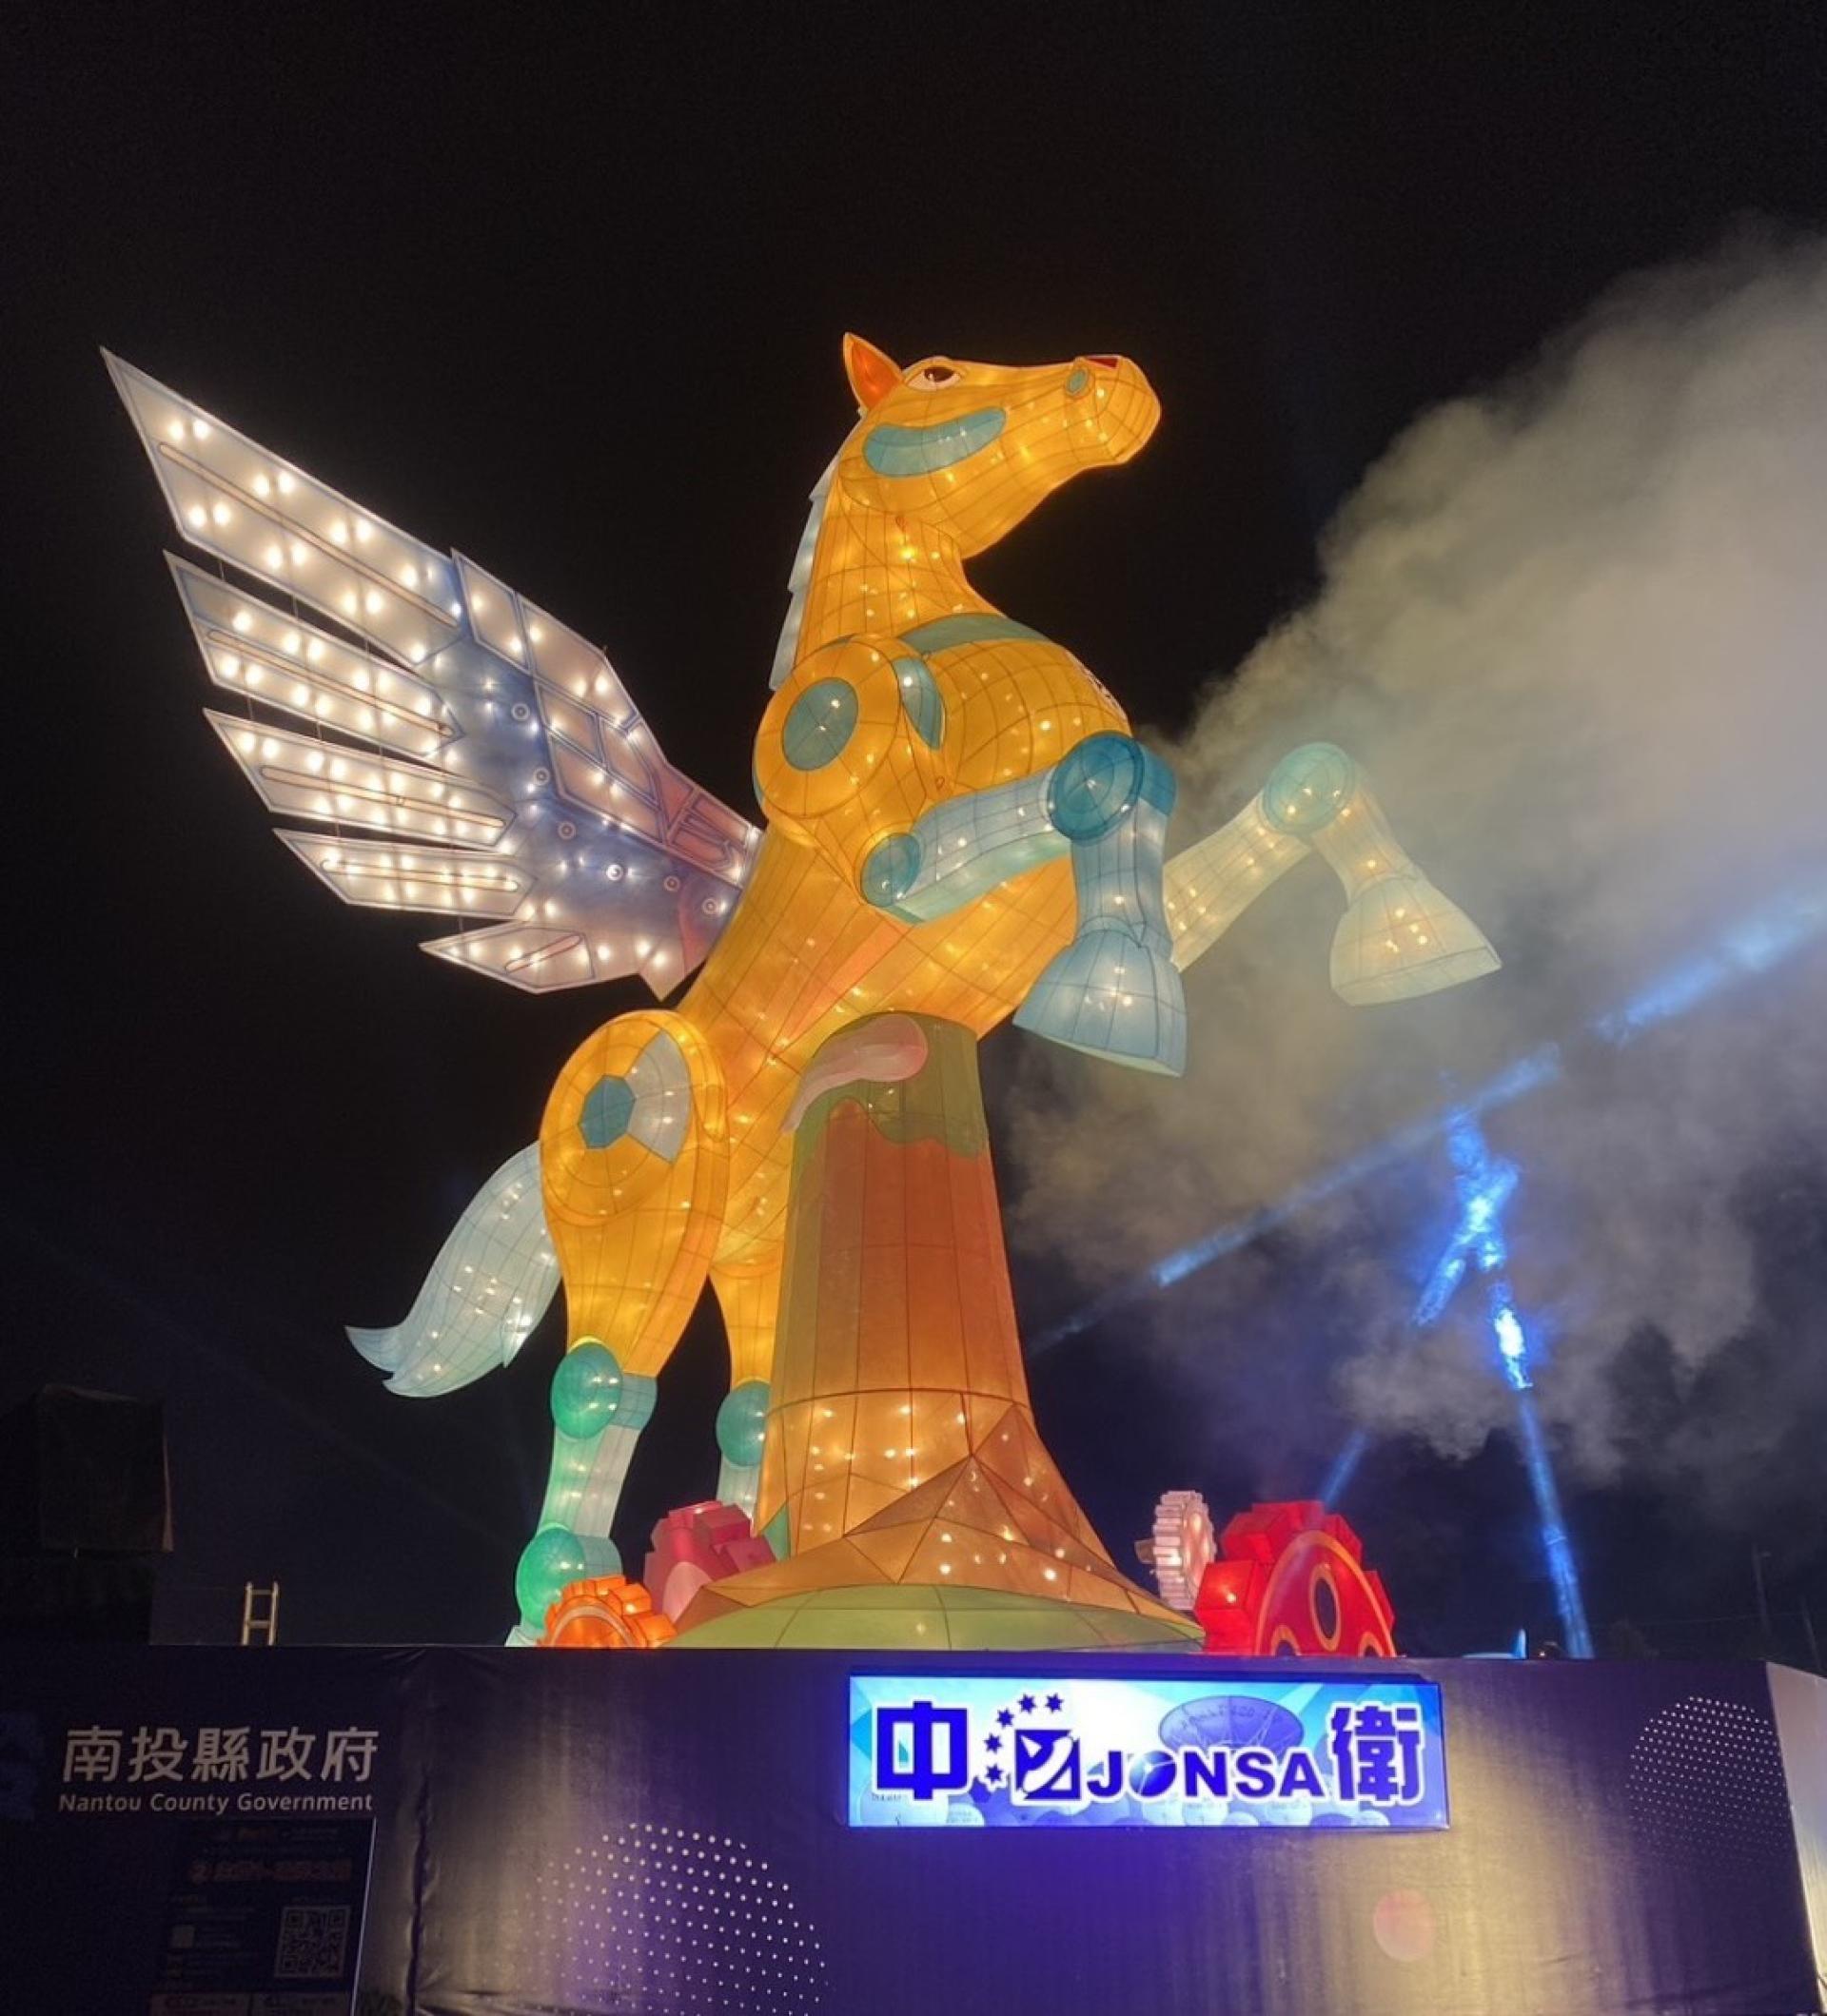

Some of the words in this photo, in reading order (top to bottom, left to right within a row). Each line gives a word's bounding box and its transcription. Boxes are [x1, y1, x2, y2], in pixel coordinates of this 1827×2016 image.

[62, 1725, 380, 1783] 南投縣政府
[876, 1700, 969, 1801] 中
[1087, 1750, 1325, 1799] JONSA
[1333, 1707, 1422, 1803] 衛
[58, 1792, 142, 1813] Nantou
[150, 1792, 229, 1815] County
[237, 1792, 374, 1812] Government
